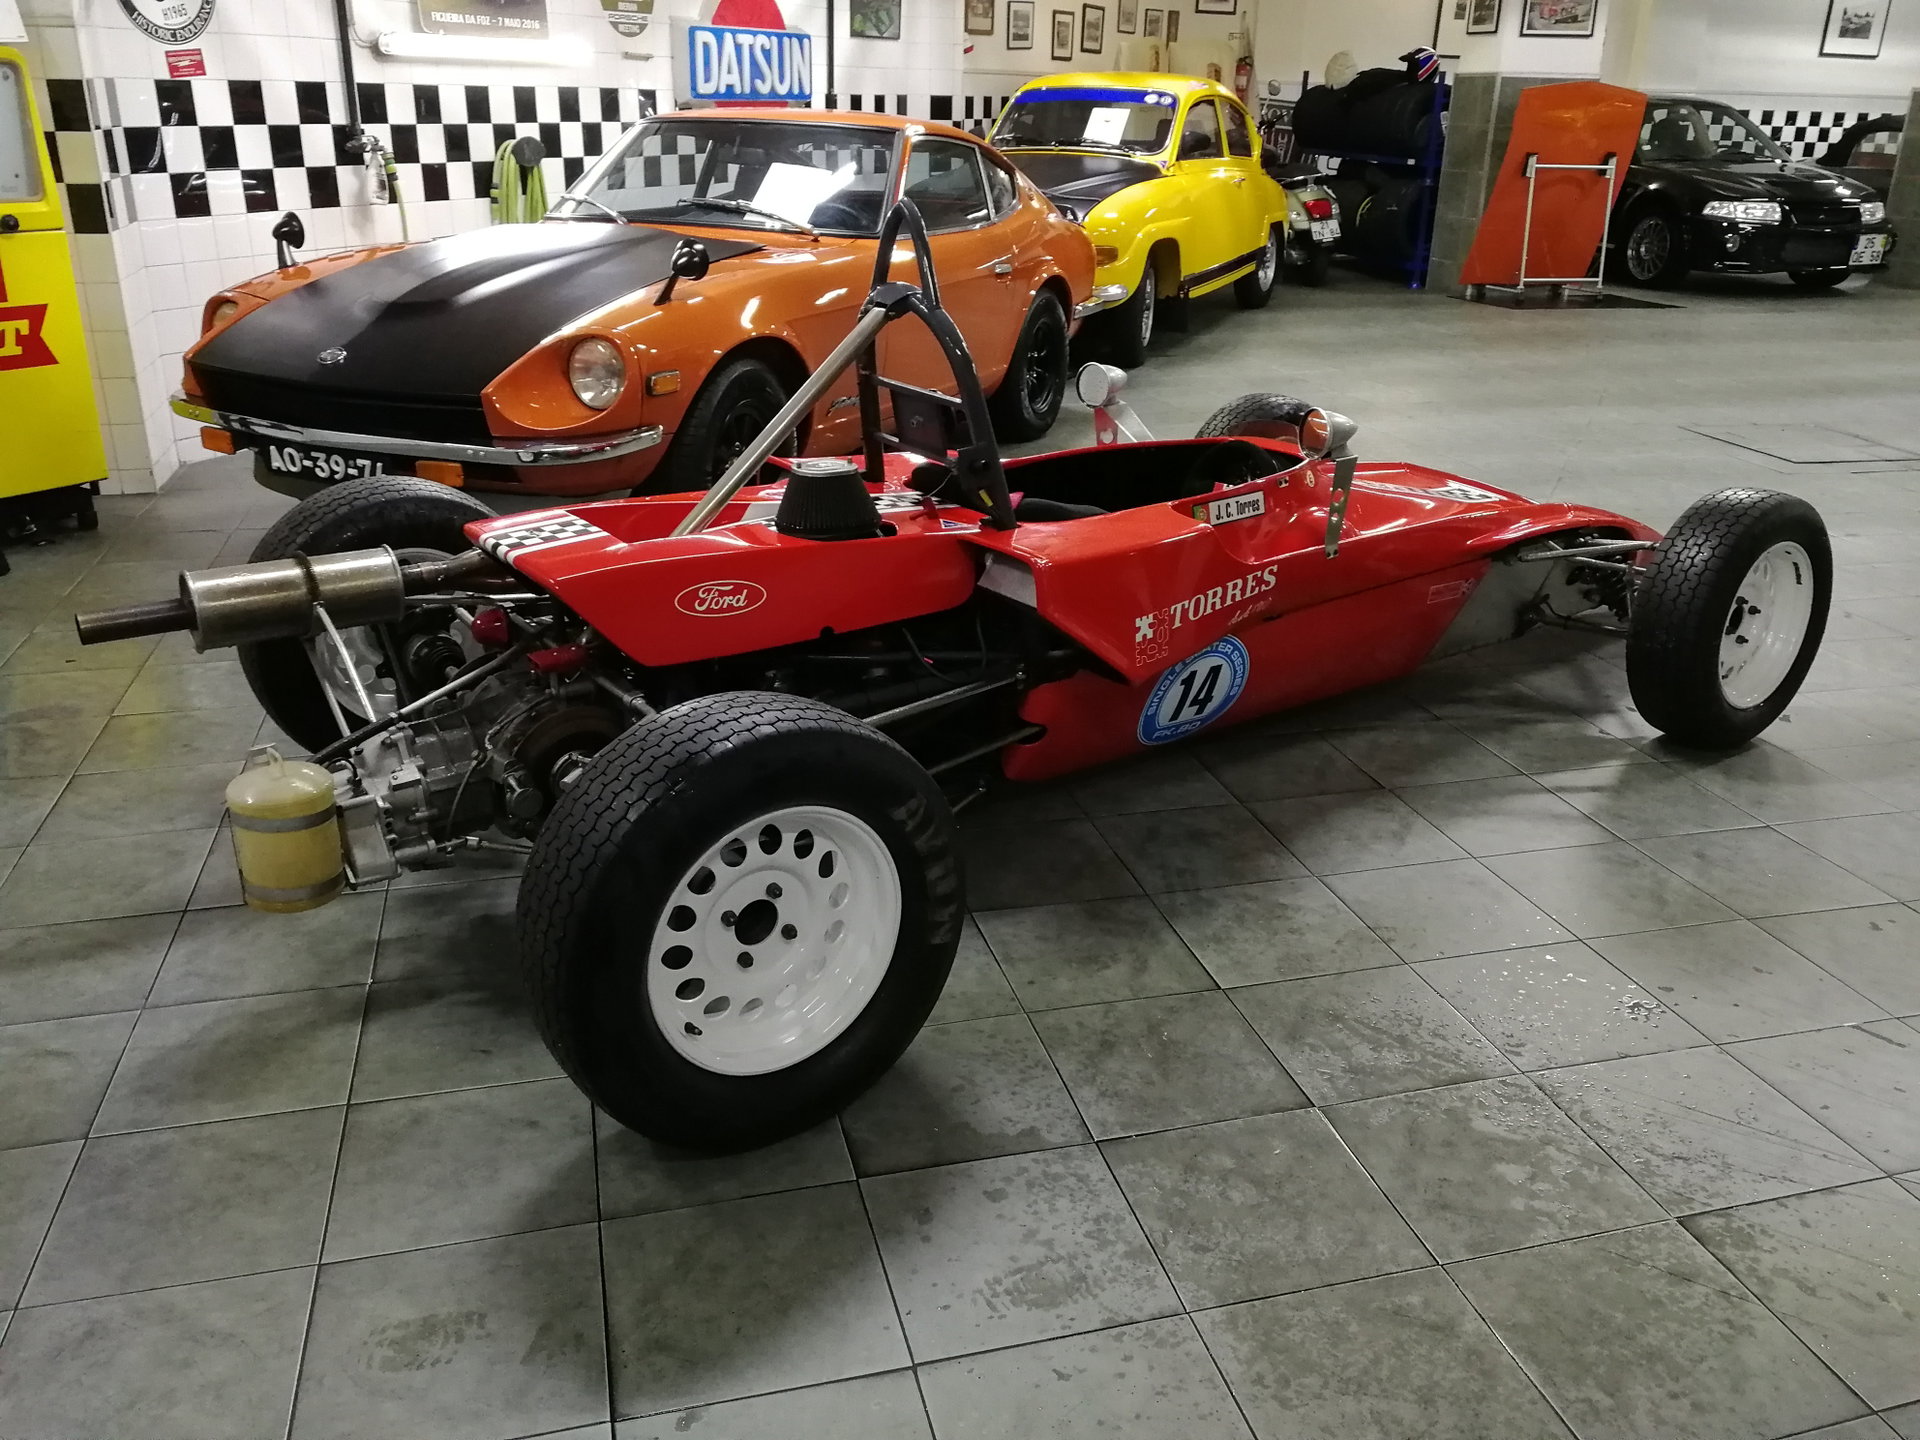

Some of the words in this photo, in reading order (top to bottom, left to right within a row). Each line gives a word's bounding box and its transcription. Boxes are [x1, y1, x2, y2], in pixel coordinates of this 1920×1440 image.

[131, 11, 176, 41] HISTORIC
[176, 0, 212, 42] ENDURANC
[431, 12, 464, 23] FIGUEIRA
[465, 15, 475, 25] DA
[476, 16, 491, 26] FOZ
[497, 17, 503, 27] 7
[503, 18, 521, 28] MAIO
[522, 19, 540, 29] 2016
[694, 30, 811, 95] DATSUN
[1864, 236, 1876, 249] 25
[1215, 504, 1224, 520] J.
[1225, 502, 1234, 518] C.
[1235, 498, 1260, 516] Torres
[694, 585, 748, 611] Ford
[1170, 565, 1278, 630] TORRES
[1147, 663, 1184, 716] SINGLE
[1230, 650, 1244, 696] SERIES
[1168, 664, 1223, 722] 14
